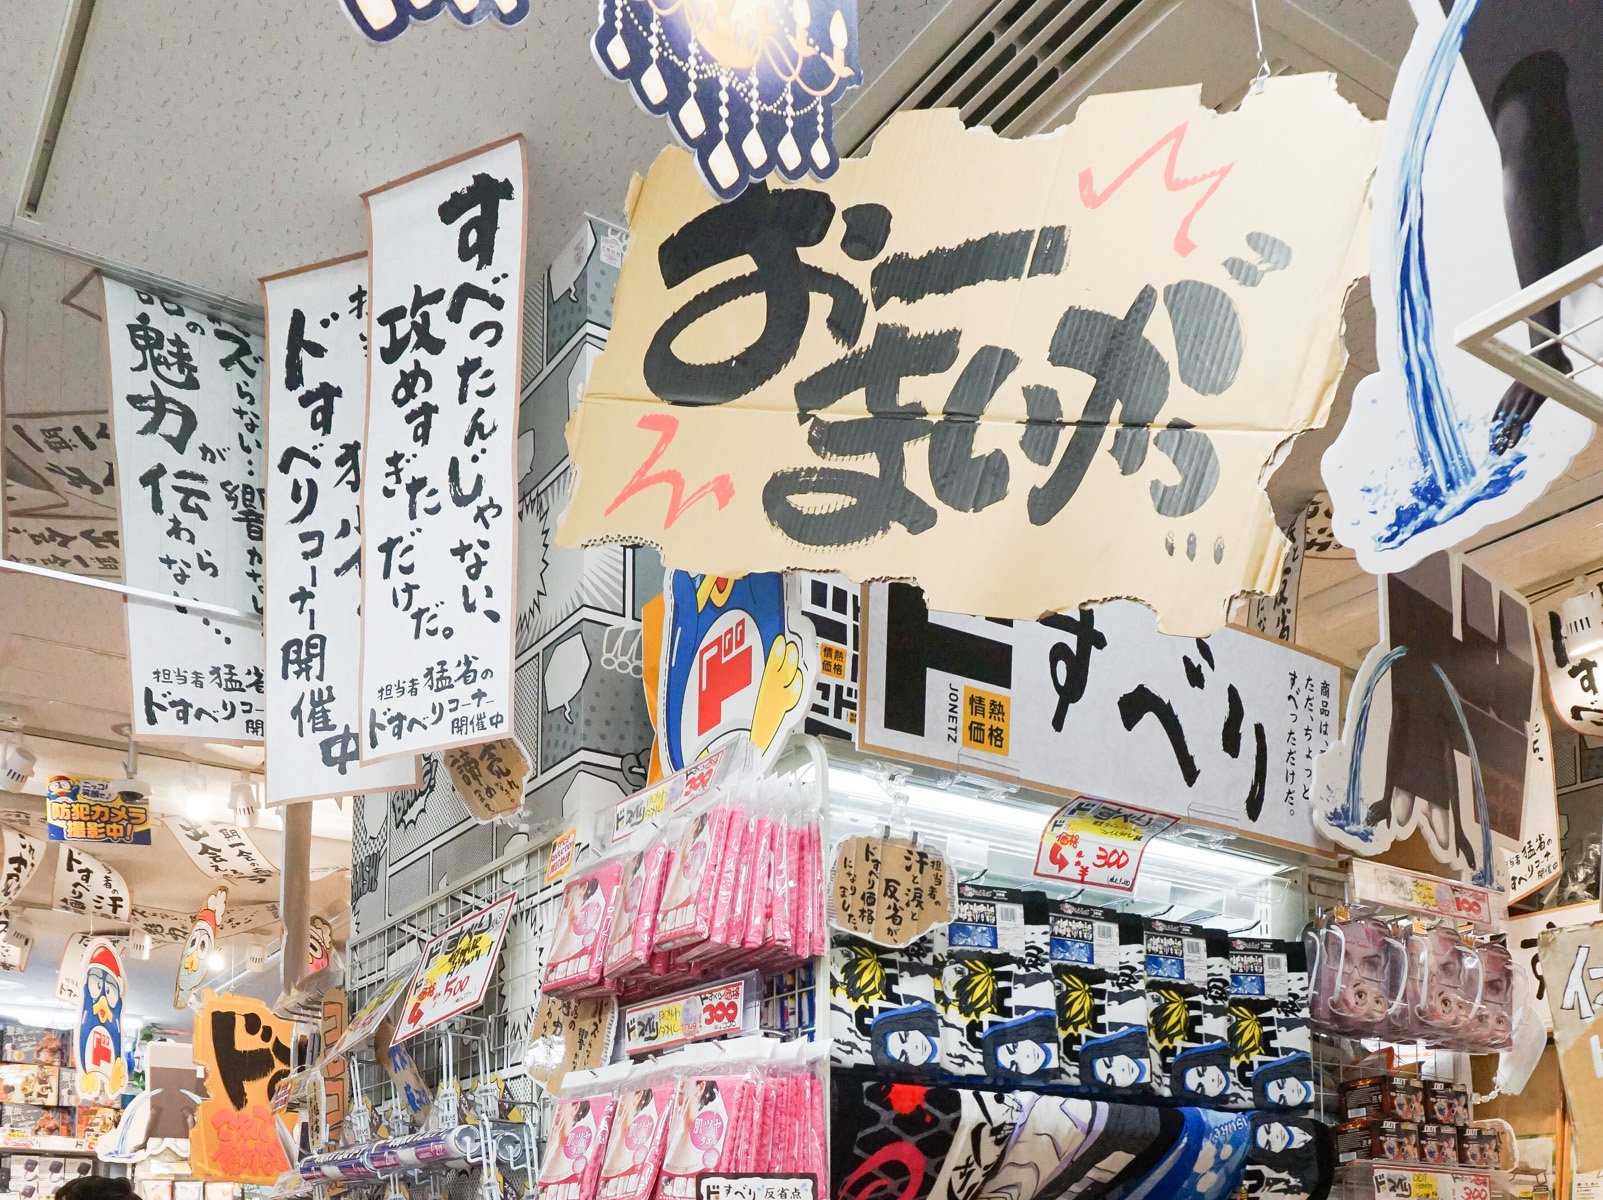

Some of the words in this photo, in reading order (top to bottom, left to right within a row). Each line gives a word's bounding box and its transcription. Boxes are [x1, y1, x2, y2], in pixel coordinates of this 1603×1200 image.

[436, 172, 515, 623] すべったんじゃない、
[377, 284, 455, 640] 攻めすぎただけだ。
[377, 653, 493, 701] 担当者猛省の
[368, 687, 495, 749] ドすべりコーナー
[450, 711, 505, 736] 開催中
[946, 682, 959, 744] JONETZ
[968, 693, 1006, 723] 情熱
[967, 720, 1005, 749] 価格
[1284, 670, 1300, 817] すべっただけだ。
[1302, 675, 1315, 801] ただ、ちょっと
[684, 768, 714, 798] 300
[51, 801, 148, 821] 防犯カメラ
[64, 819, 135, 841] 撮影中!
[1092, 846, 1130, 870] 300
[839, 856, 858, 931] になりました。
[858, 842, 882, 926] ドすべり価格
[903, 848, 929, 922] 汗と涙と
[927, 859, 943, 907] 担当者の
[1454, 896, 1482, 916] 100
[882, 878, 905, 944] 反省が、
[702, 1000, 738, 1026] 300
[764, 1187, 803, 1200] 反省点
[1461, 1186, 1488, 1200] 300
